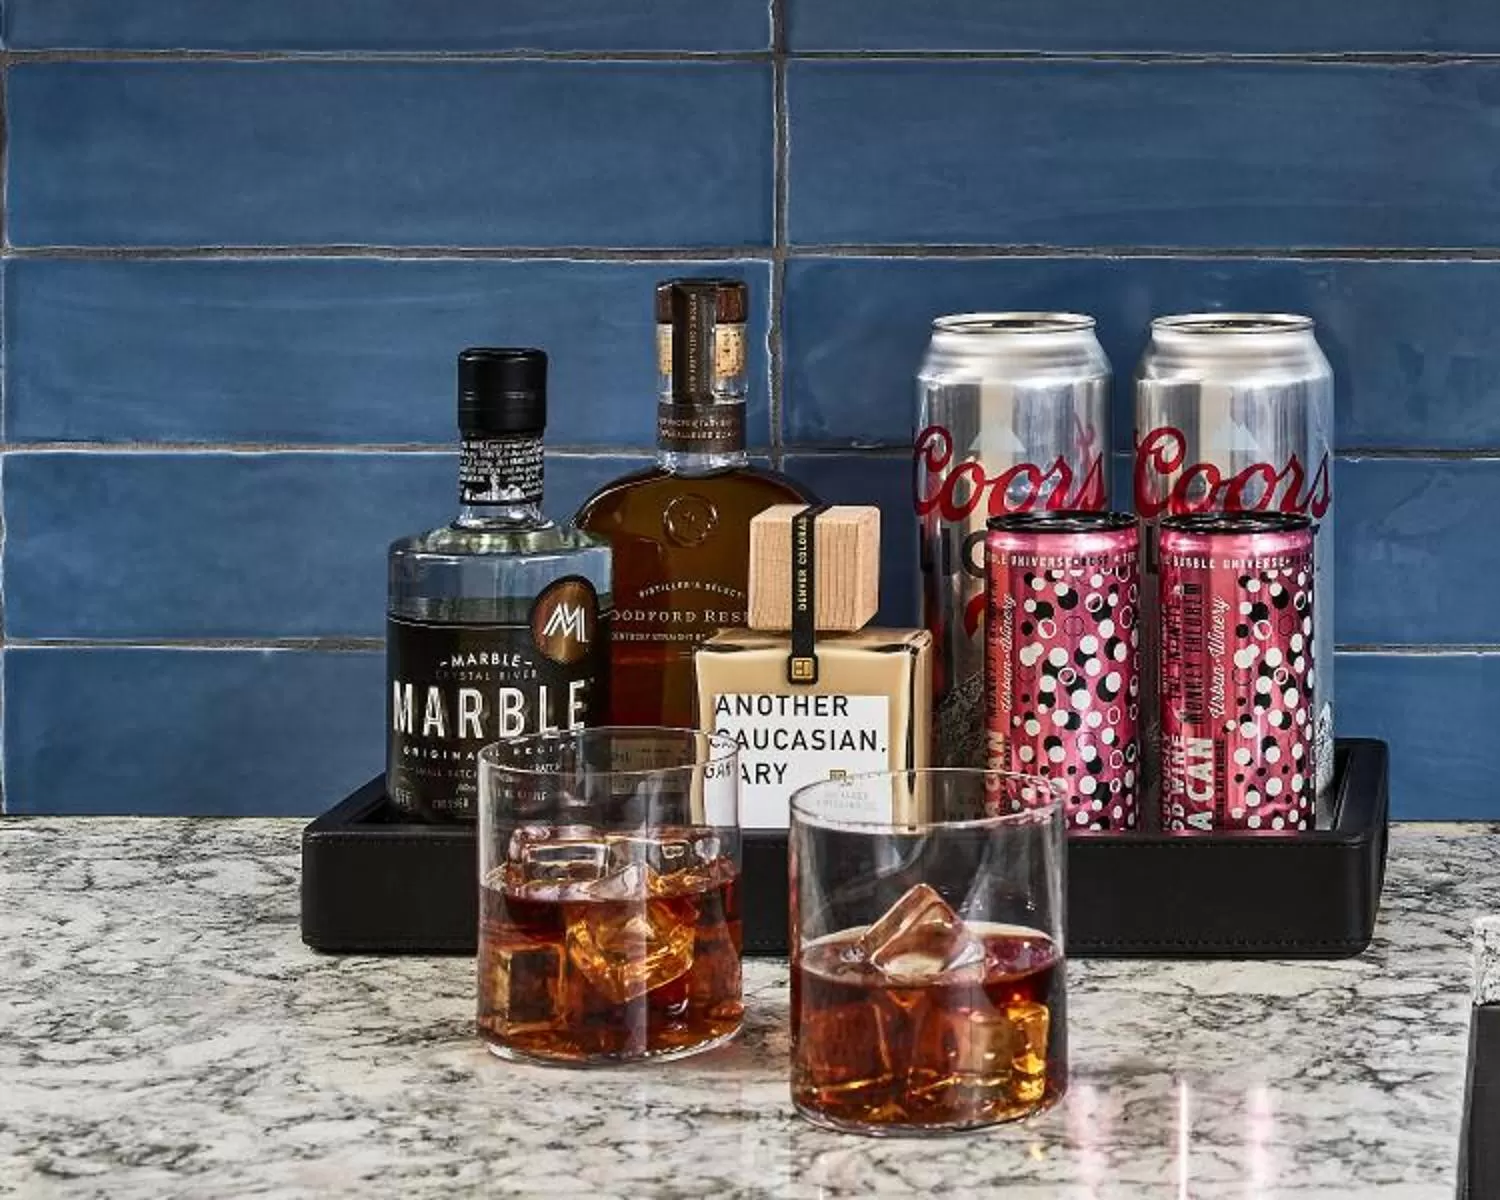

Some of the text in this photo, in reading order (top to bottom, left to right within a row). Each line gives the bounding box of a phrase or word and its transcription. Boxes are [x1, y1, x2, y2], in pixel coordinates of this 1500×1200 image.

[913, 425, 1107, 521] Coors
[1133, 426, 1331, 520] Coors
[920, 523, 987, 579] LIG
[611, 609, 697, 623] OODFORD
[797, 569, 807, 611] DENVER
[451, 652, 521, 668] MARBLE
[393, 679, 586, 740] MARBLE
[715, 694, 849, 717] ANOTHER
[1171, 732, 1185, 795] WINE
[1186, 737, 1214, 831] A CAN
